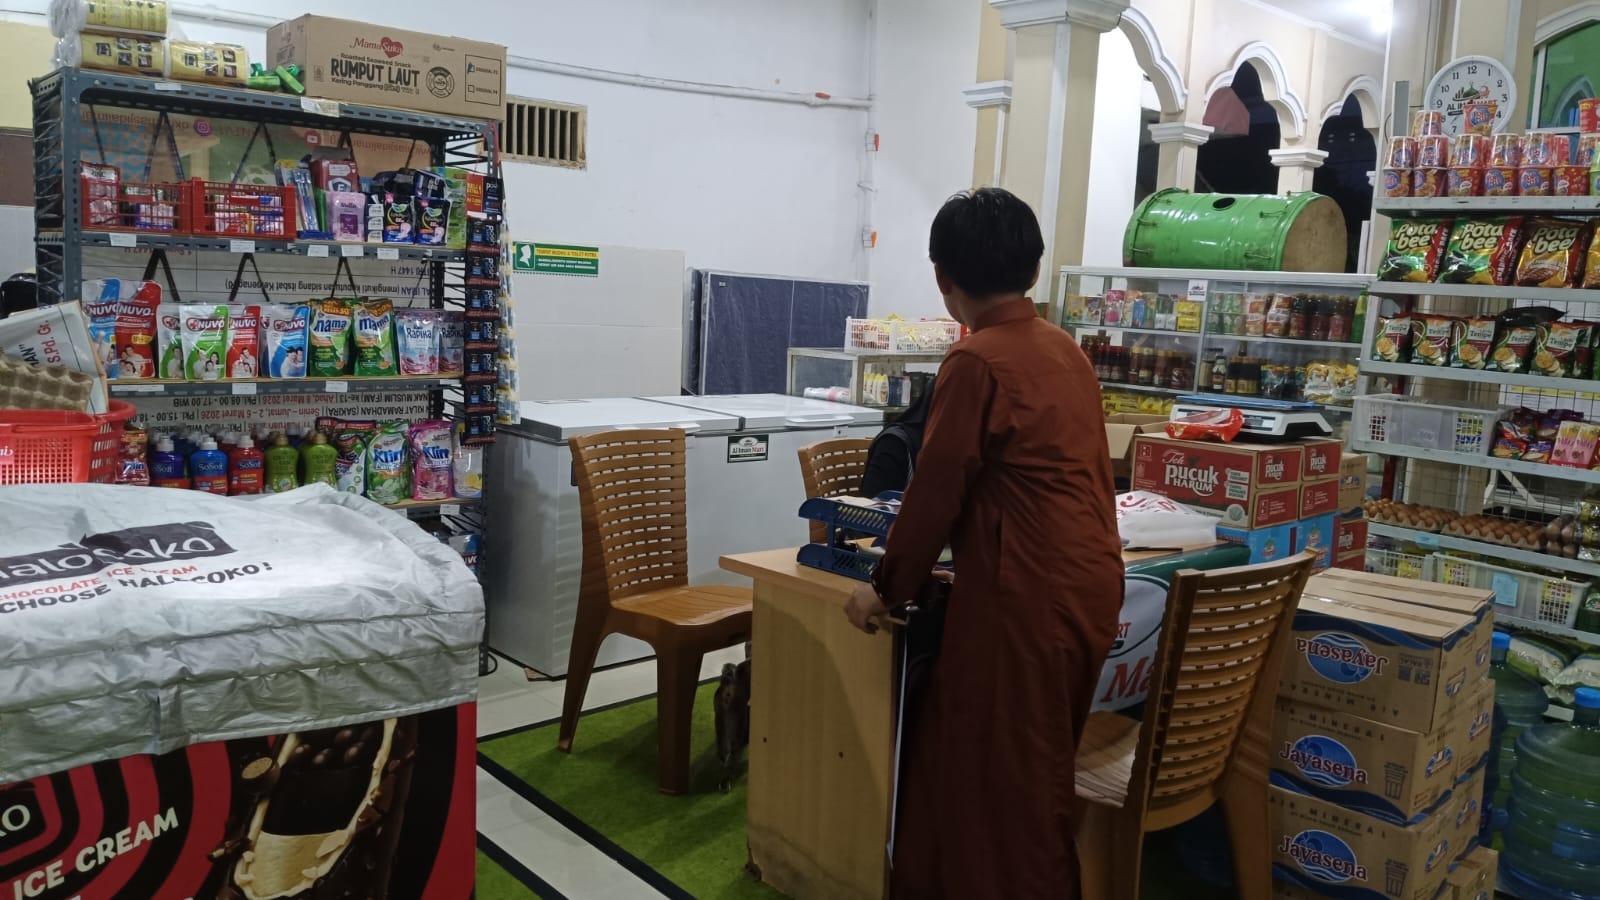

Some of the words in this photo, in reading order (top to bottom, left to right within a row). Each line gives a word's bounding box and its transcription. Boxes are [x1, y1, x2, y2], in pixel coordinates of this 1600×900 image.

[349, 37, 381, 50] Mama
[331, 58, 385, 83] RUMPUT
[388, 66, 420, 87] LAUT
[1467, 65, 1477, 75] 12
[1488, 68, 1492, 77] 1
[1453, 72, 1459, 80] 11
[1442, 85, 1449, 93] 10
[1497, 80, 1503, 88] 2
[1501, 94, 1508, 103] 3
[1437, 100, 1443, 108] 9
[1396, 223, 1439, 238] Pota
[1462, 223, 1505, 238] Pota
[1533, 226, 1580, 242] Pota
[1397, 234, 1431, 251] bee
[1461, 234, 1498, 251] bee
[1534, 238, 1572, 254] bee
[276, 282, 297, 291] itsbat
[298, 281, 322, 291] sidang
[118, 305, 152, 317] NUVO
[198, 318, 225, 329] NUVO
[231, 319, 256, 328] NUVO
[1469, 330, 1493, 340] Tempe
[1550, 338, 1573, 348] Tempe
[191, 398, 212, 407] 17.00
[241, 396, 257, 405] Pkl.
[262, 396, 281, 405] 2026
[282, 395, 305, 404] Maret
[339, 394, 360, 403] ke-13
[361, 393, 383, 403] (FAM)
[384, 393, 413, 402] MUSLIM
[173, 398, 190, 408] WIB
[200, 410, 220, 420] 2026
[221, 409, 245, 419] Maret
[299, 407, 321, 417] Senin
[325, 406, 359, 417] (SAKIRA)
[359, 406, 404, 416] RAMADHAN
[405, 406, 425, 415] KILAT
[157, 411, 178, 421] 15.00
[181, 411, 195, 421] Pkl.
[374, 449, 403, 463] Klin
[422, 446, 449, 460] Klin
[1162, 450, 1185, 464] Teh
[1173, 477, 1216, 496] HARUM
[106, 567, 135, 579] ICE
[0, 584, 111, 614] CHOOSE
[1295, 637, 1390, 676] Jayasena
[1279, 741, 1368, 785] Jayasena
[0, 804, 31, 836] O
[14, 860, 65, 900] ICE
[75, 807, 179, 873] CREAM
[1279, 836, 1368, 882] Jayasena
